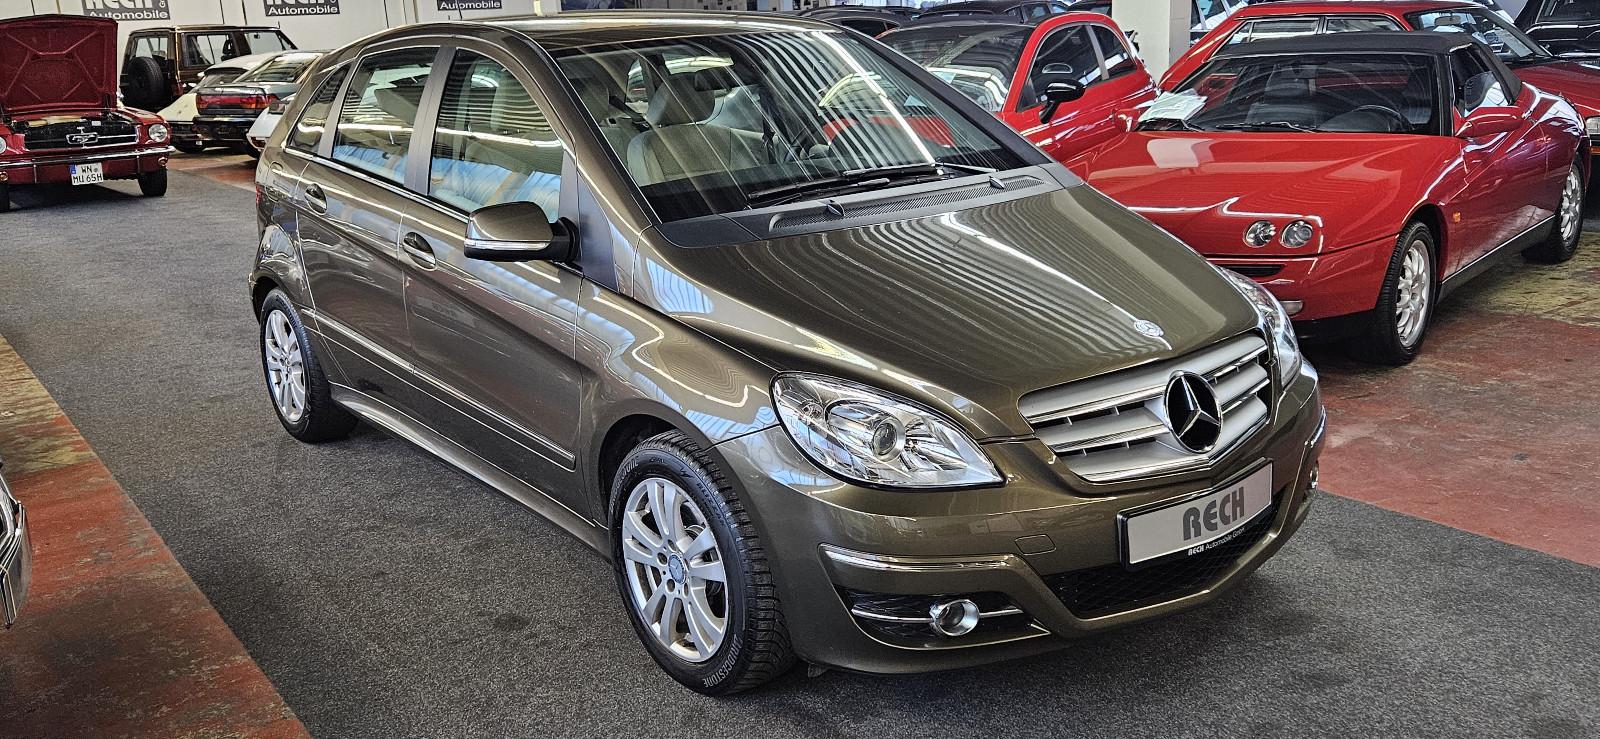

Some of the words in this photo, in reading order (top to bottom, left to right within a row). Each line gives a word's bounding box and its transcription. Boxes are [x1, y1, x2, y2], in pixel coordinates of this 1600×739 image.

[268, 5, 338, 15] Automobile
[1183, 486, 1245, 541] RECH
[1188, 545, 1205, 556] RECH
[1205, 534, 1232, 550] Automobile
[702, 633, 744, 688] BRIDGESTONE
